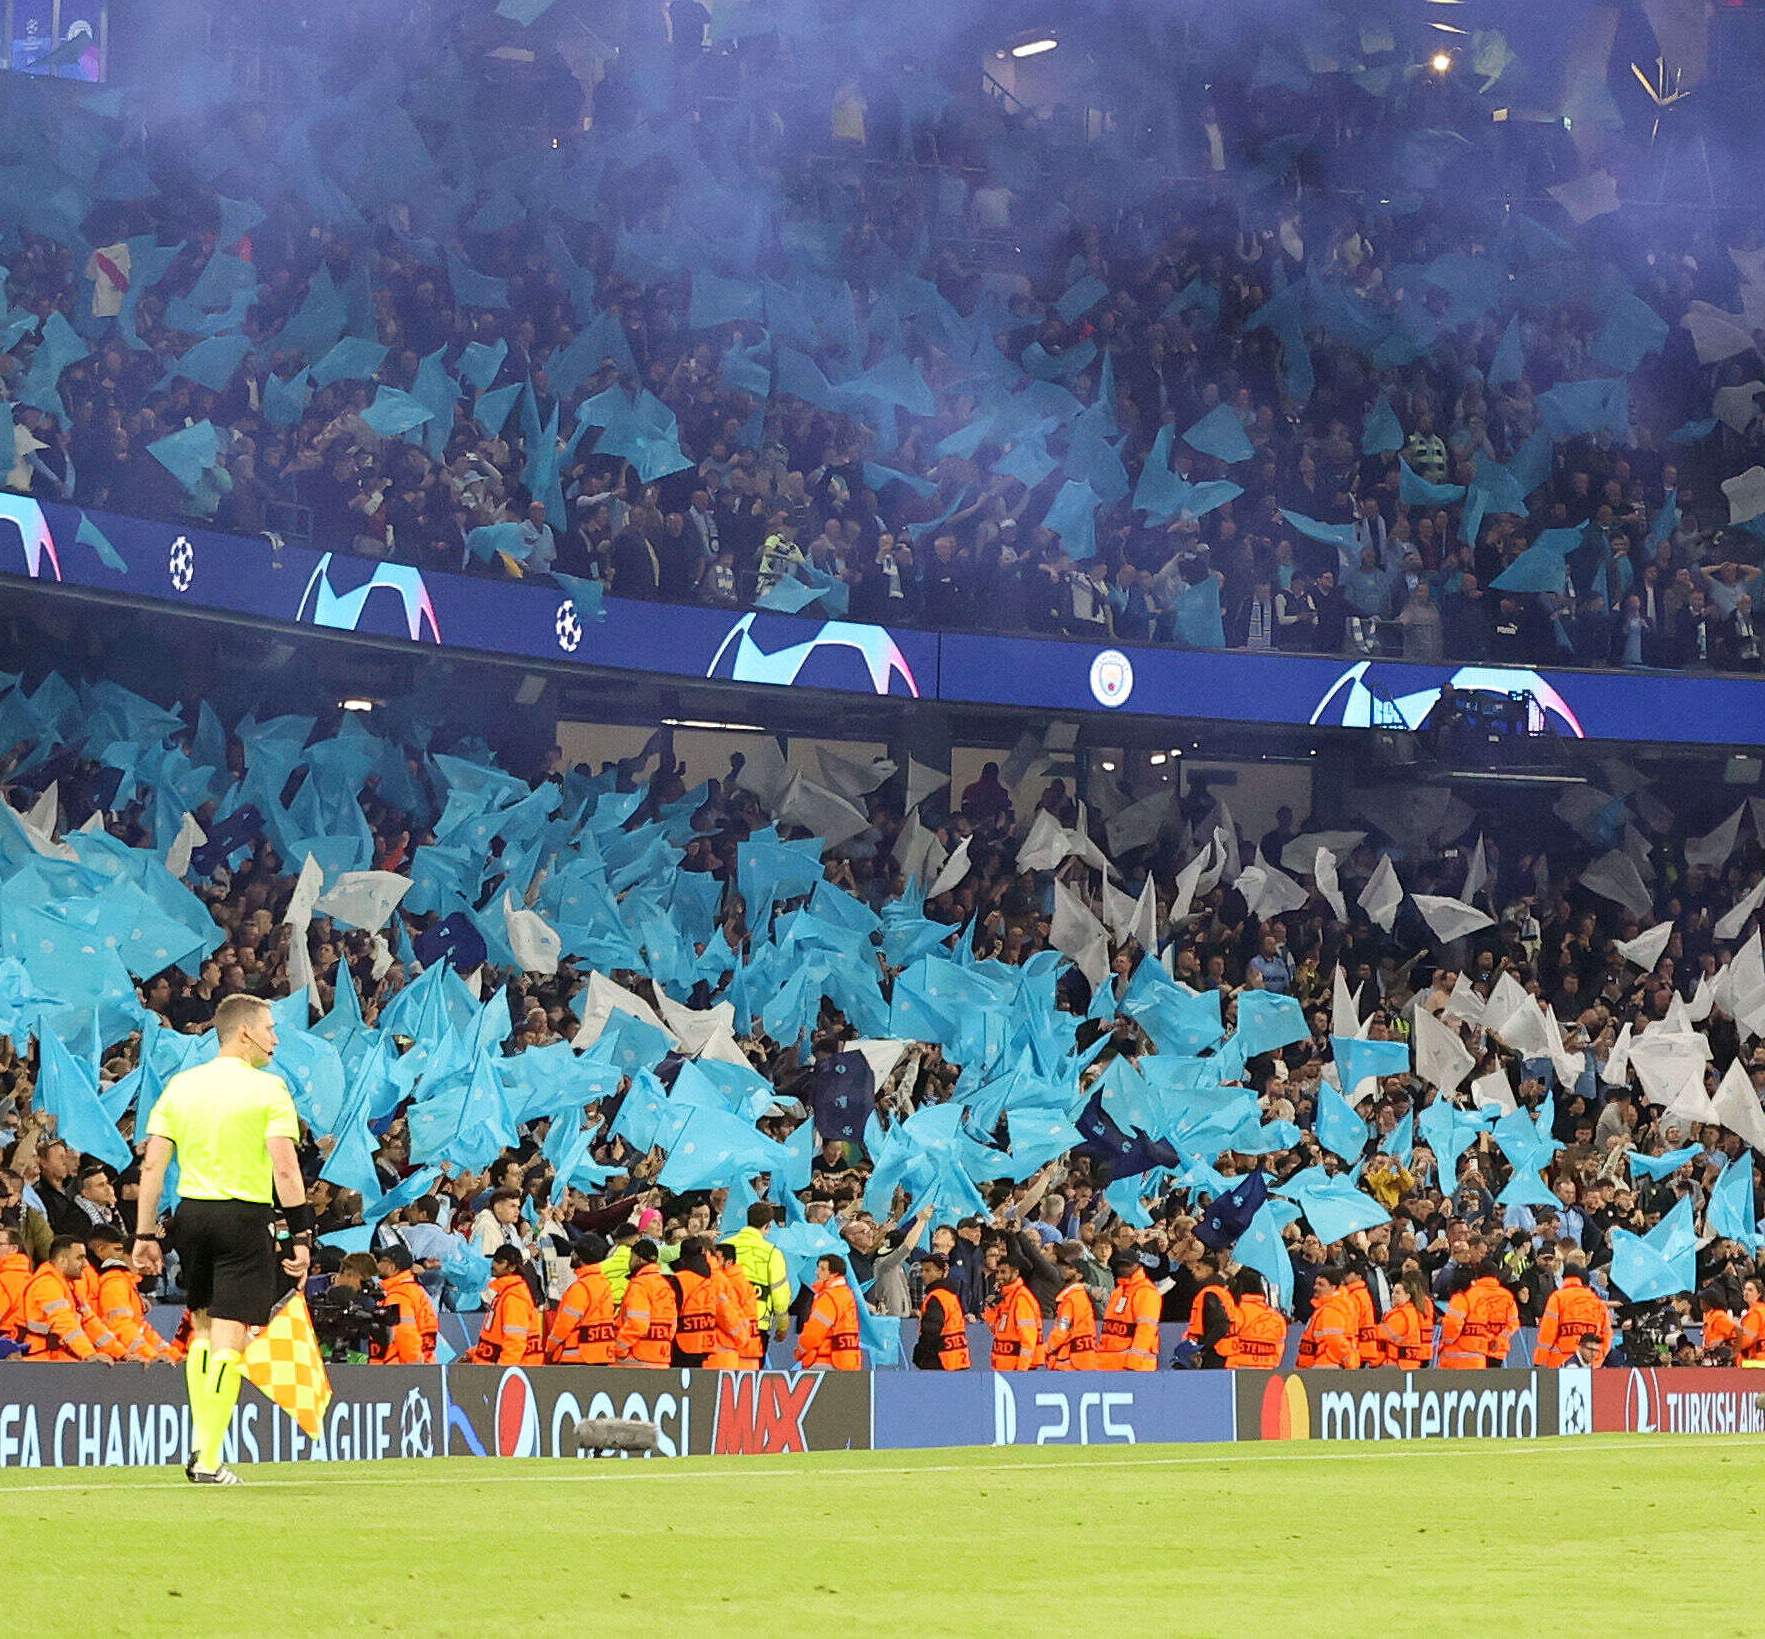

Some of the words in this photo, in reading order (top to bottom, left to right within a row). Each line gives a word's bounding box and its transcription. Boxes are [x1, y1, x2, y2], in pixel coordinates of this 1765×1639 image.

[54, 1402, 261, 1467] CHAMPINS
[711, 1370, 826, 1456] MAX
[1321, 1371, 1538, 1440] mastercard
[1667, 1392, 1737, 1435] TURKISH
